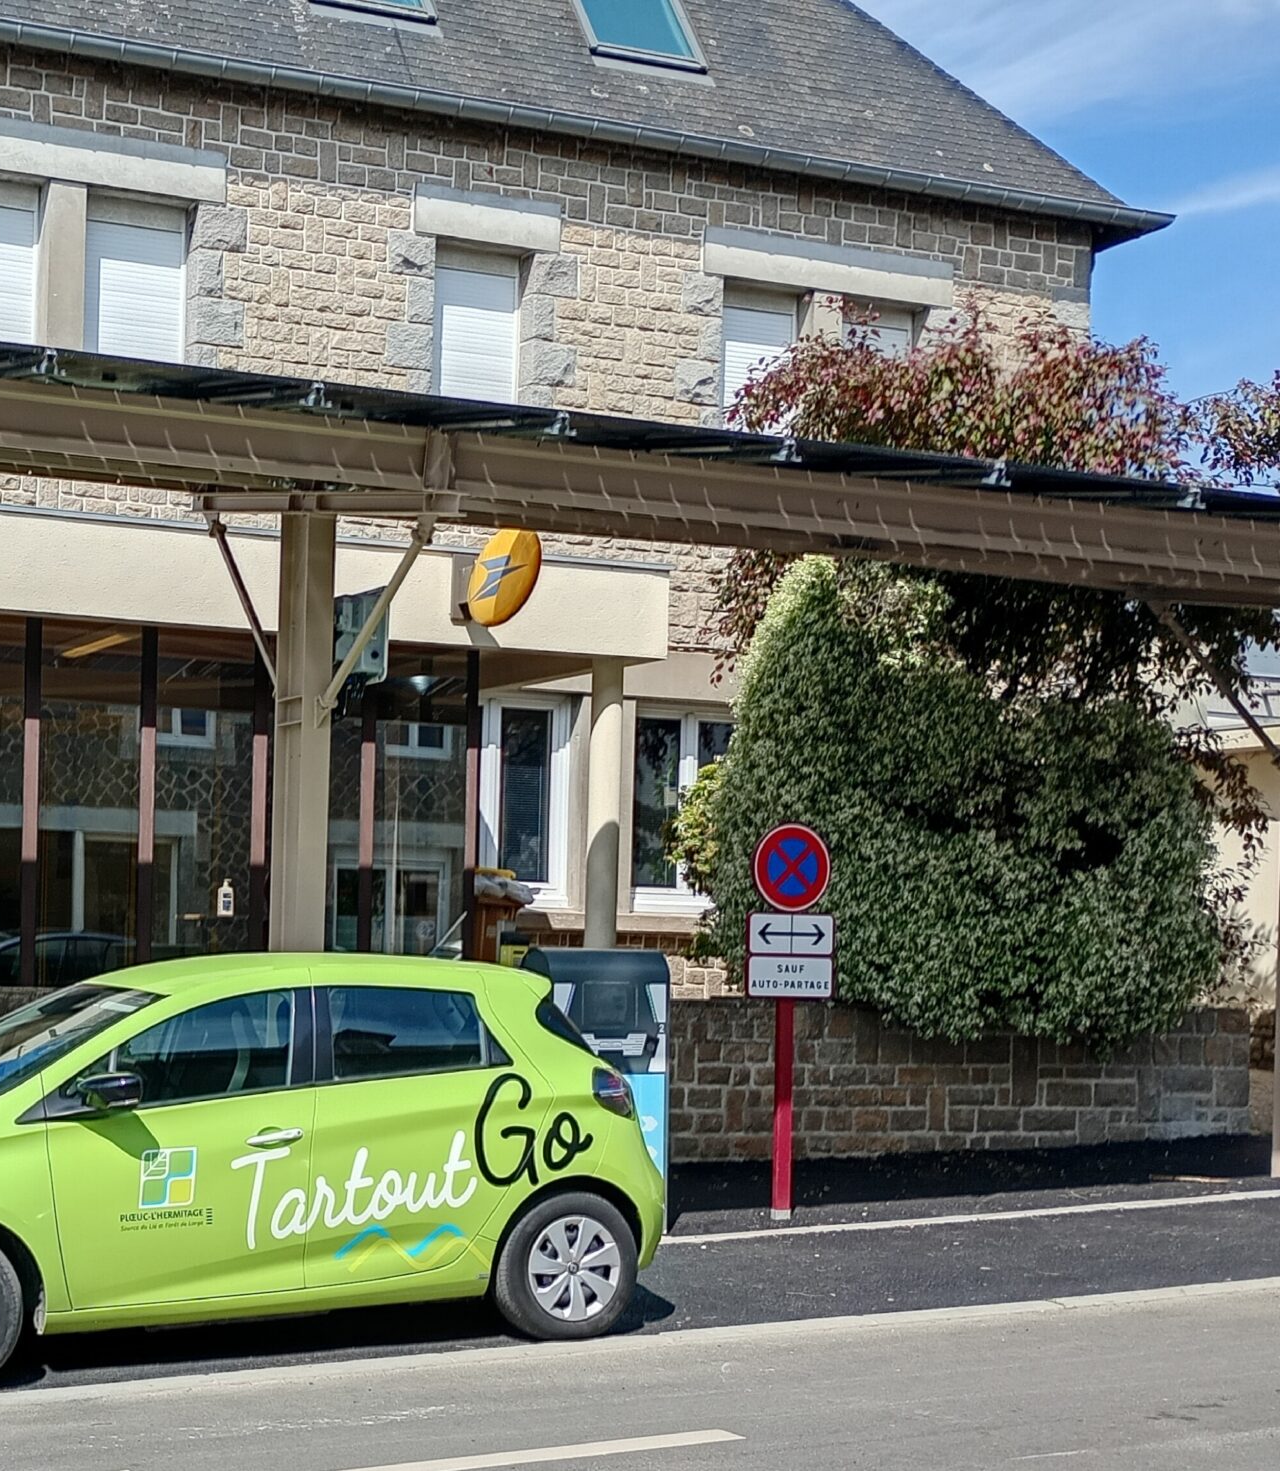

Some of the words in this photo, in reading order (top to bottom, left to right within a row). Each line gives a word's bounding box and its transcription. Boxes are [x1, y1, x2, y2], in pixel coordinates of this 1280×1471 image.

[777, 964, 805, 973] SAUF
[751, 979, 829, 990] AUTO-PARTAGE
[658, 1023, 665, 1033] 2
[230, 1129, 478, 1251] Tartout
[474, 1073, 594, 1186] Go
